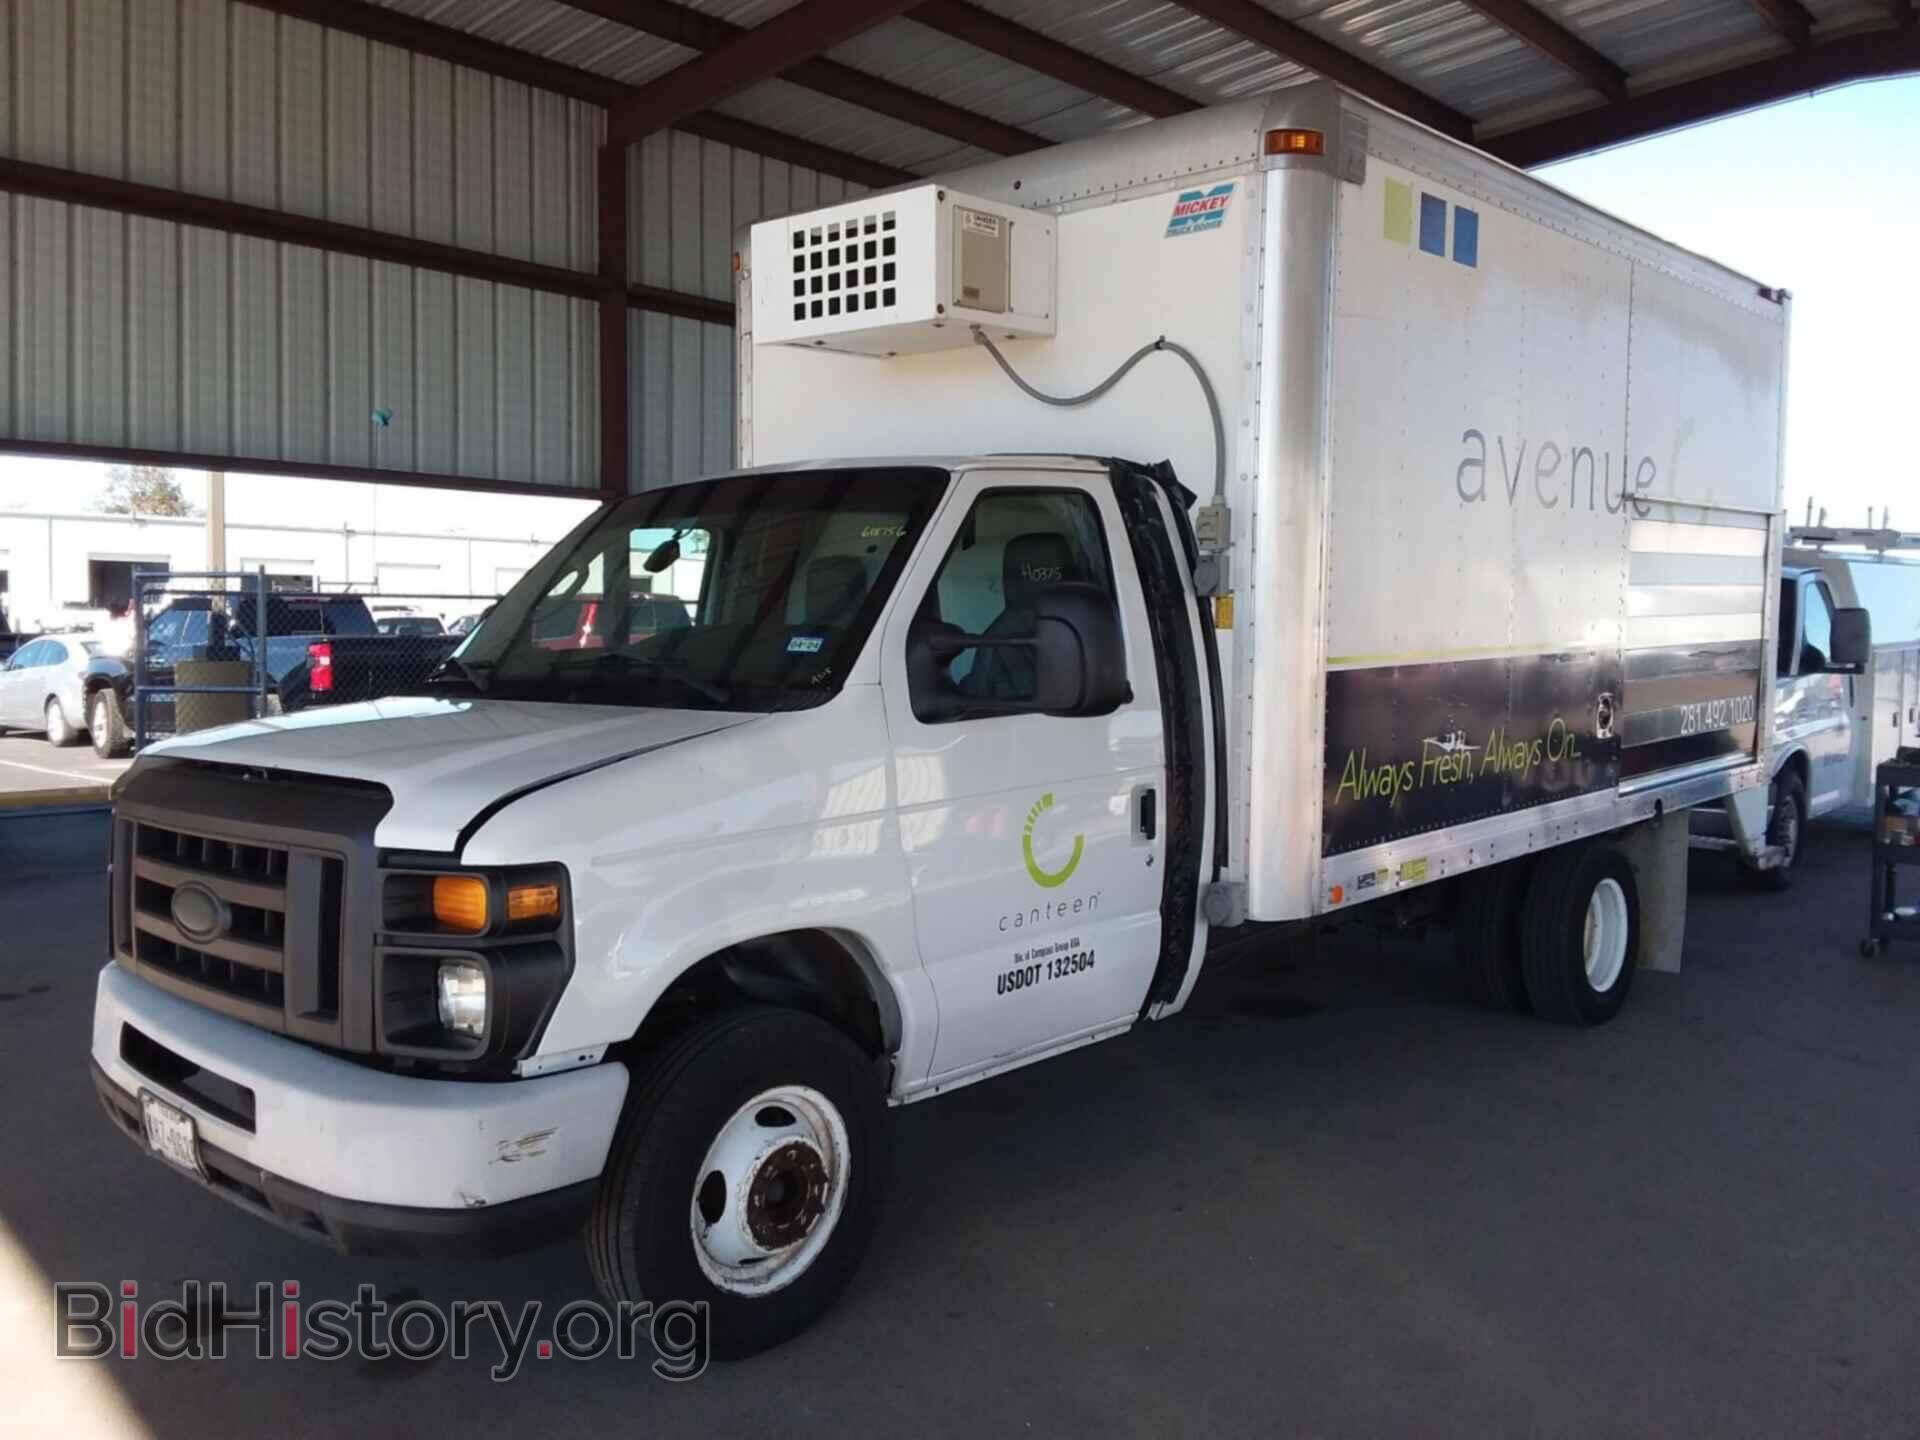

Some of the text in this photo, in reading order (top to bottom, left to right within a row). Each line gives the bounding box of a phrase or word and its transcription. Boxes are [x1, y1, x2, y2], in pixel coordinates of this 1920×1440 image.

[1172, 196, 1230, 217] MICKEY
[1456, 428, 1657, 517] avenue
[1333, 747, 1416, 808] Always
[1420, 737, 1474, 788] Fresh,
[1479, 728, 1543, 780] Always
[998, 894, 1099, 932] canteen
[997, 948, 1095, 996] USDOT 132504
